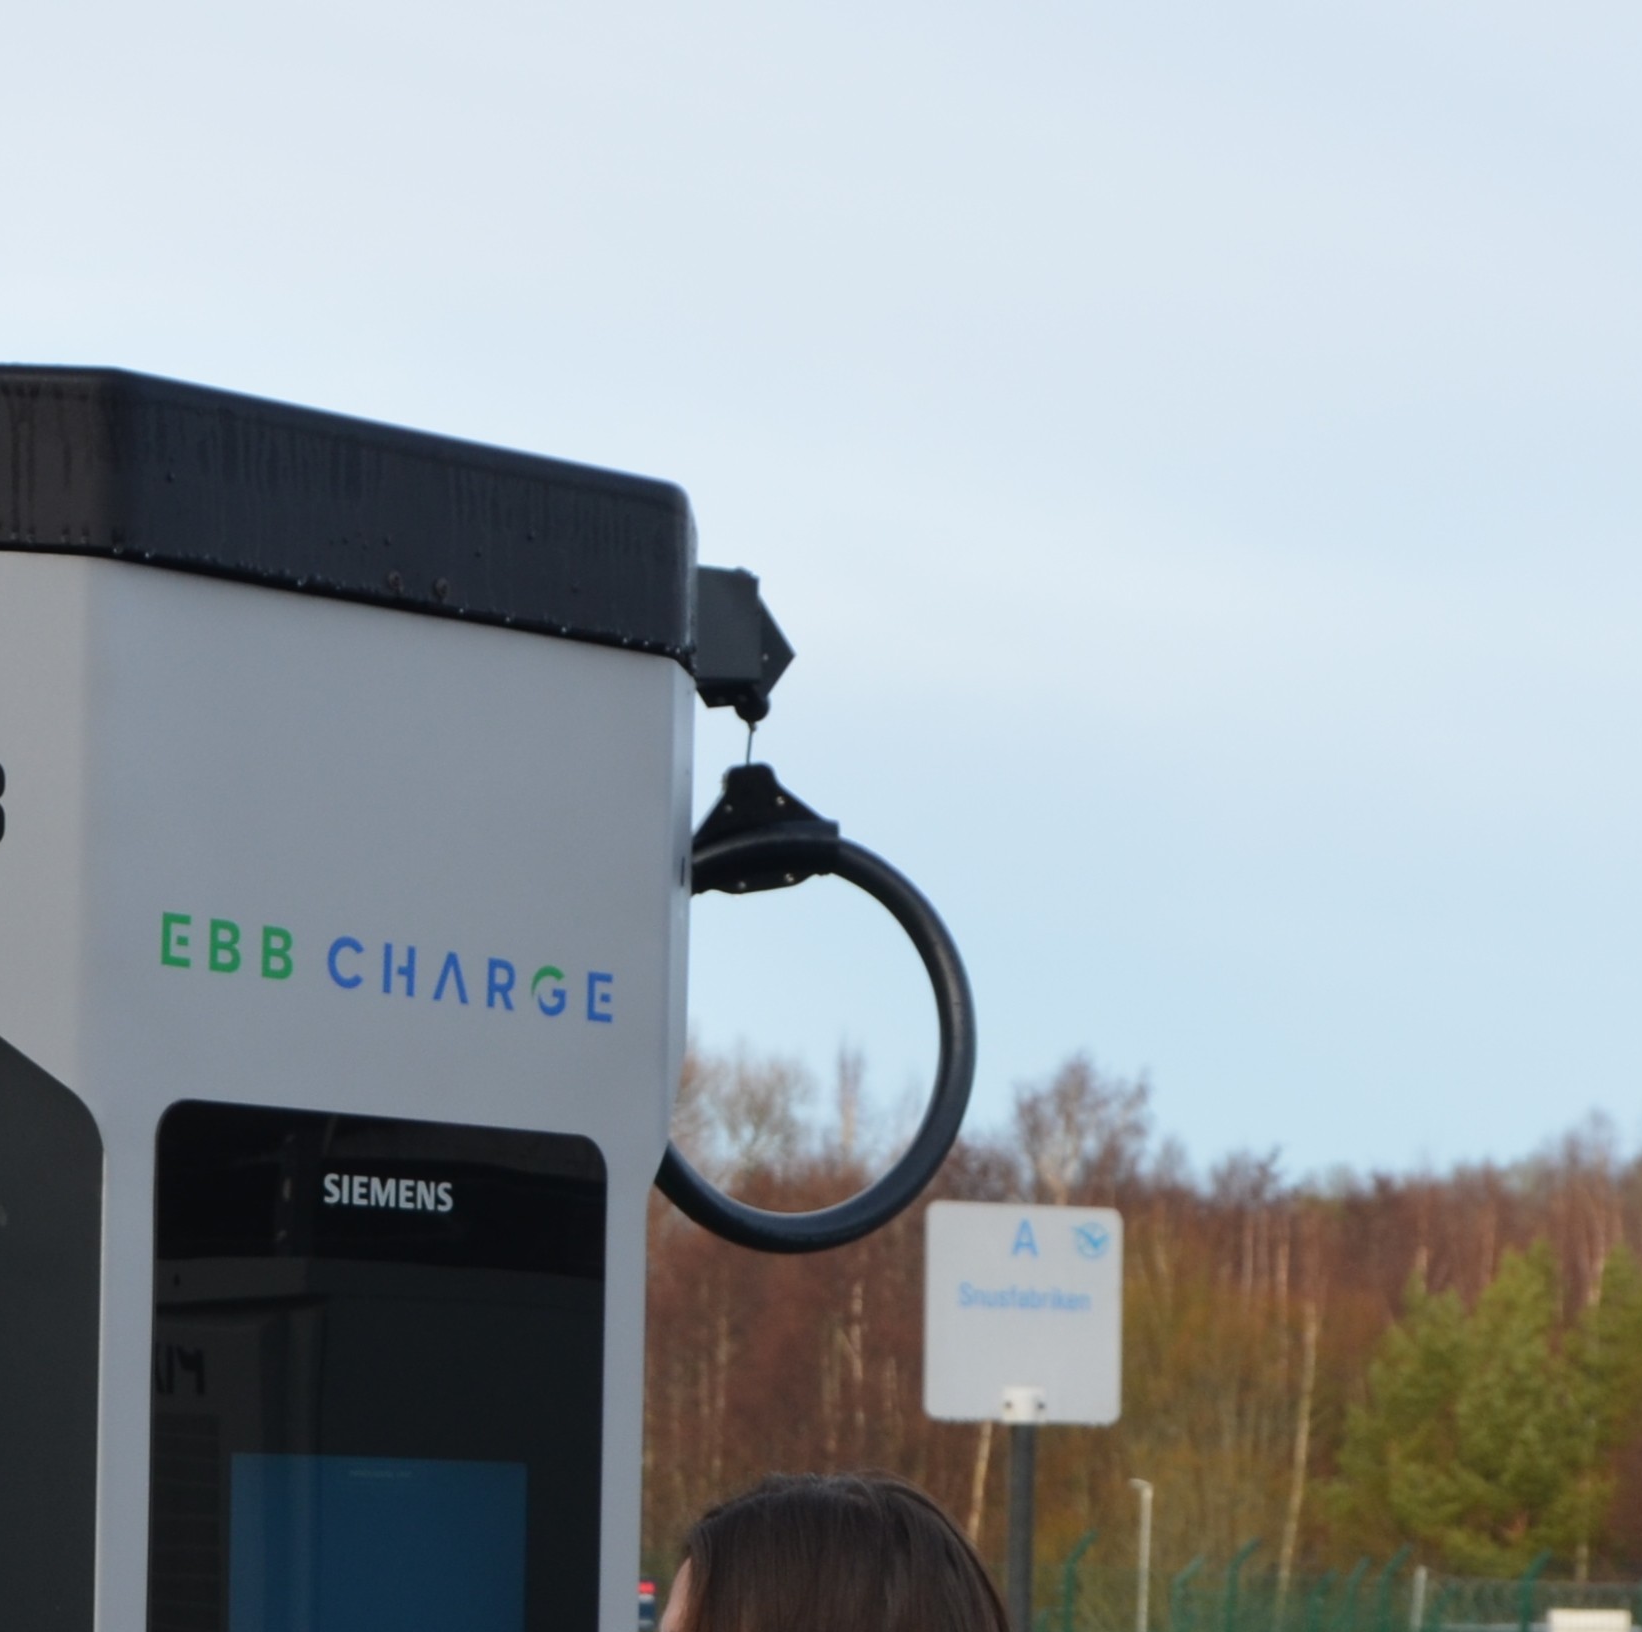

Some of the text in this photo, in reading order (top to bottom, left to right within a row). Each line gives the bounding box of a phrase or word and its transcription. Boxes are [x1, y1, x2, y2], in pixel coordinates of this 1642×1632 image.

[160, 911, 614, 1024] EBB CHARGE
[323, 1173, 454, 1213] SIEMENS
[1011, 1218, 1039, 1257] A
